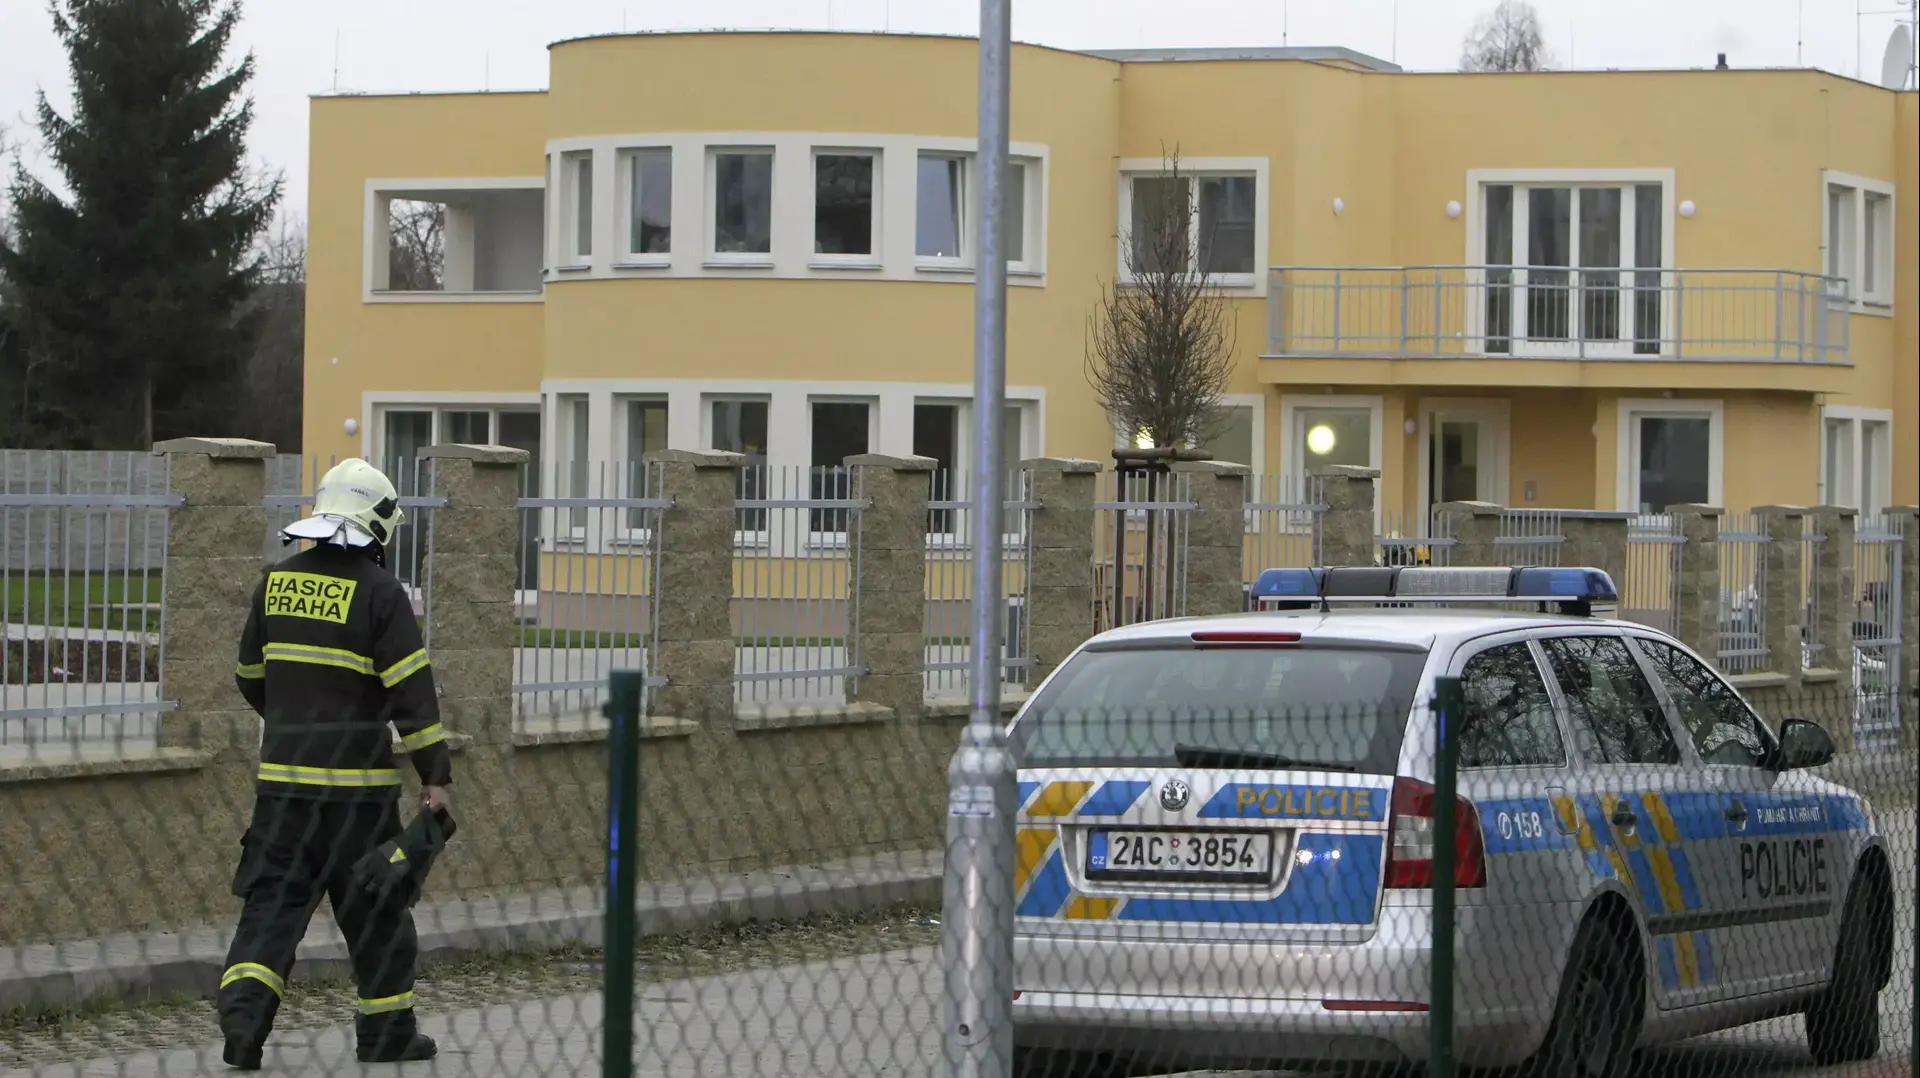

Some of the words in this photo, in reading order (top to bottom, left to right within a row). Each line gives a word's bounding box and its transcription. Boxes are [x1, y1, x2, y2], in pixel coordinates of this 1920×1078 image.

[269, 577, 350, 601] HASIČI
[267, 596, 342, 620] PRAHA
[1235, 787, 1372, 818] POLICIE
[1514, 812, 1542, 838] 158
[1092, 855, 1105, 865] CZ
[1113, 836, 1163, 865] 2AC
[1186, 837, 1255, 867] 3854
[1740, 839, 1827, 899] POLICIE
